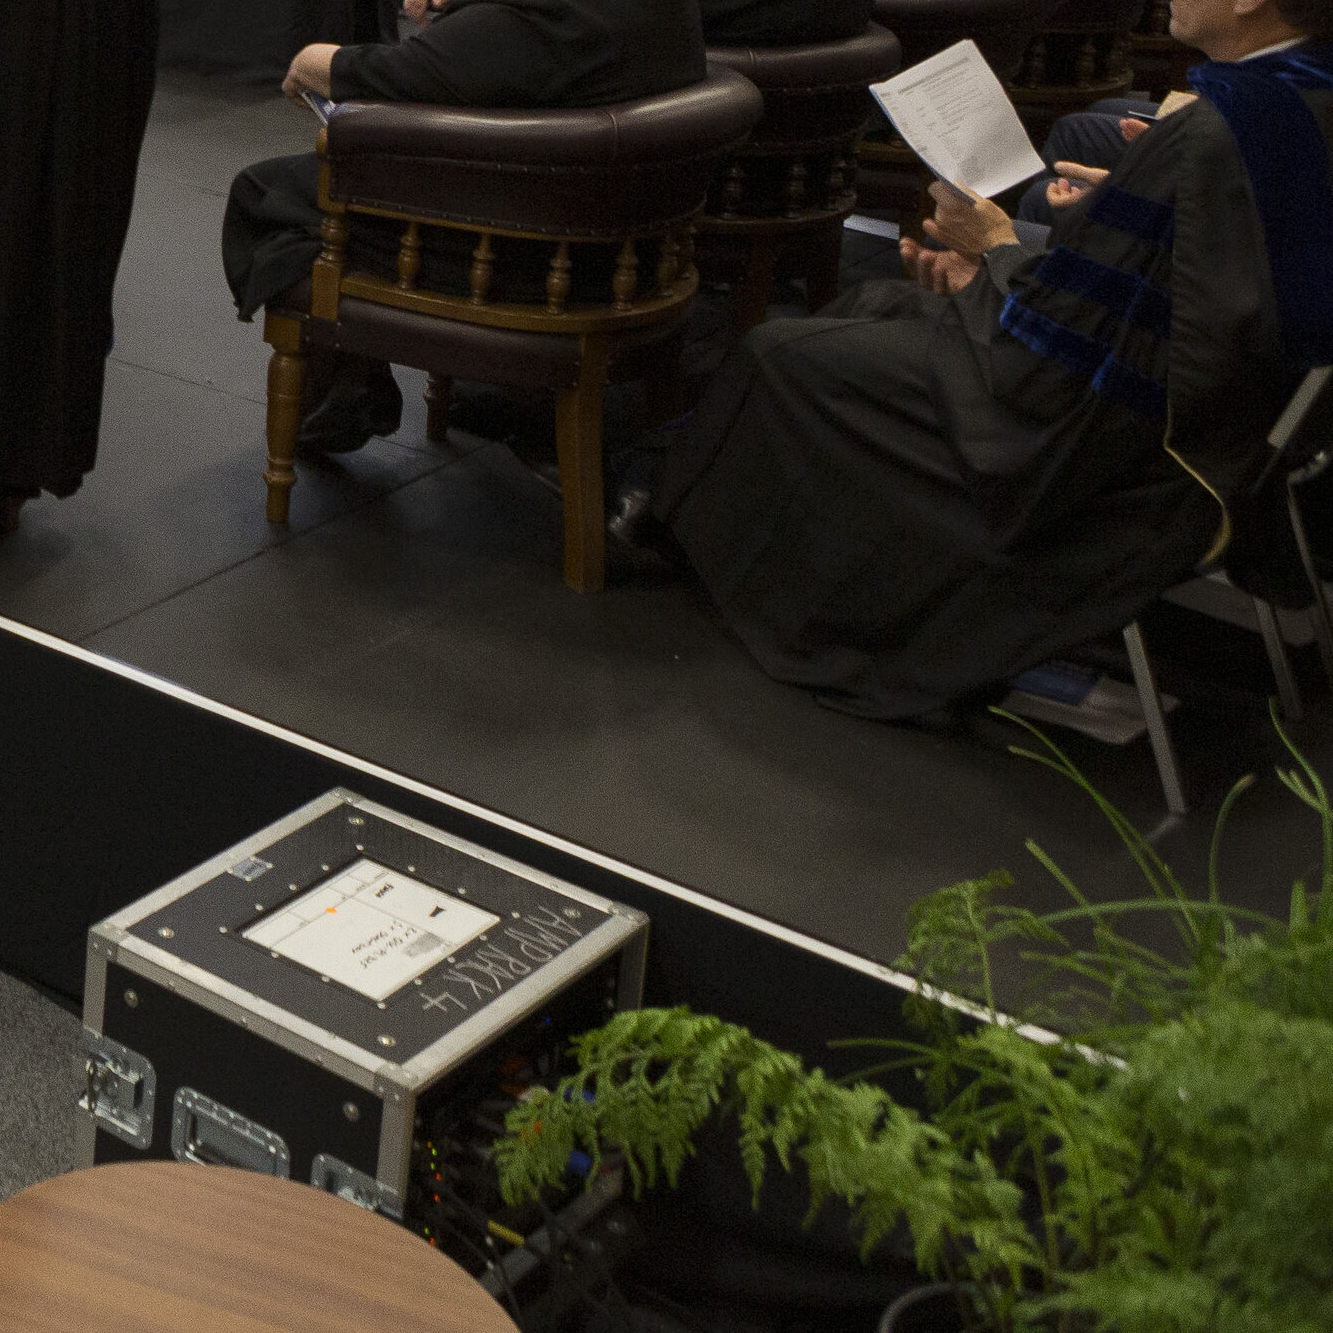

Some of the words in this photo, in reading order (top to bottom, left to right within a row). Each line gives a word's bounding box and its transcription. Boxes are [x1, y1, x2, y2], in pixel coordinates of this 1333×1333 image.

[504, 906, 582, 962] AMP
[443, 944, 531, 1000] RACK
[419, 991, 468, 1012] 4
